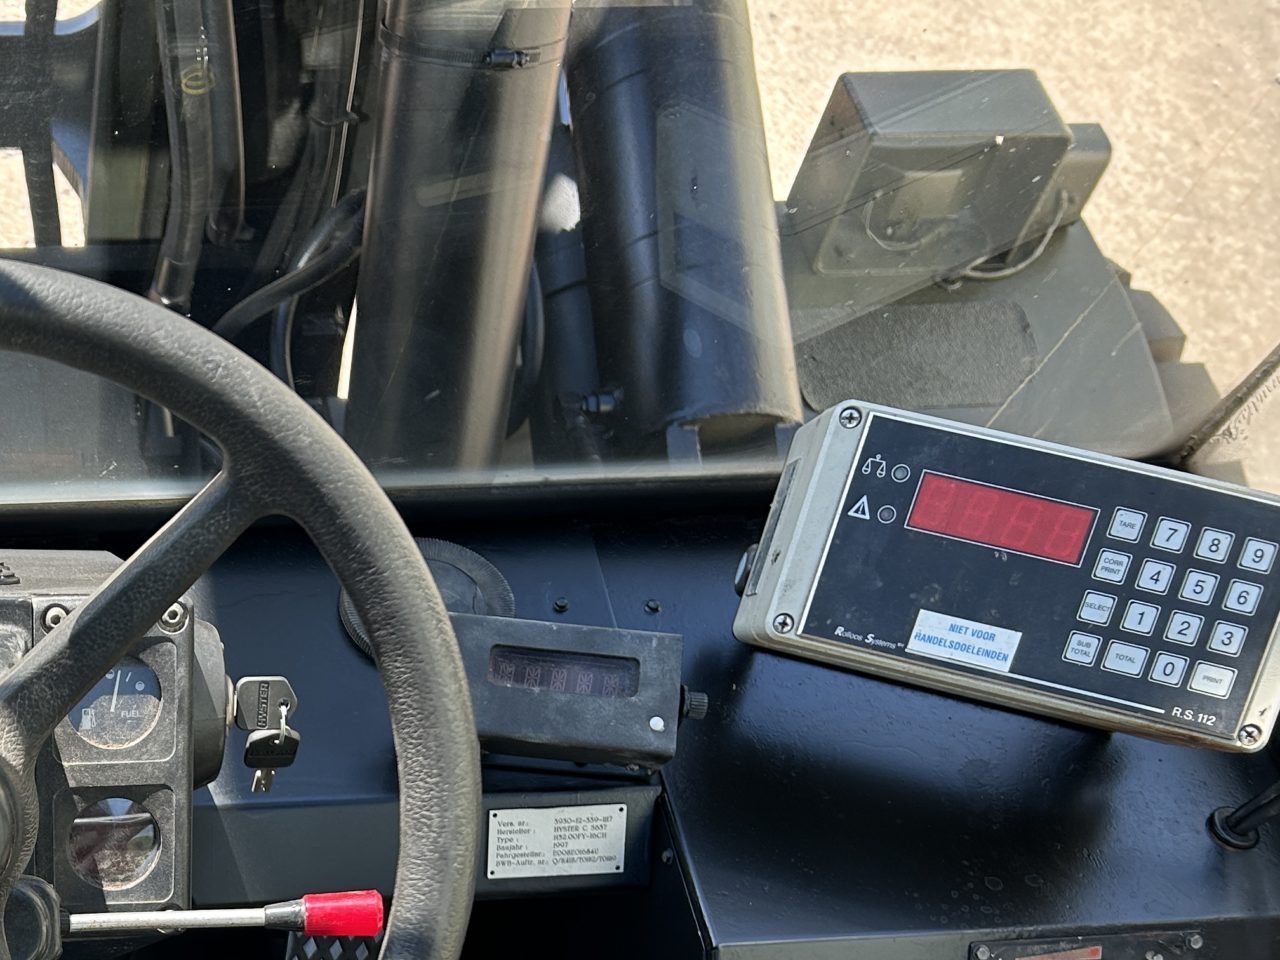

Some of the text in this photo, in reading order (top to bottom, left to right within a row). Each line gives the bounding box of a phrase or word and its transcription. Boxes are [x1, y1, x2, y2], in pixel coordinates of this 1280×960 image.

[1119, 520, 1137, 530] TARE
[1167, 528, 1178, 543] 7
[1209, 538, 1221, 553] 8
[1252, 549, 1265, 564] 9
[1100, 565, 1121, 576] PRINT
[1150, 570, 1162, 585] 4
[1192, 580, 1207, 595] 5
[1236, 591, 1250, 605] 6
[1085, 601, 1110, 612] SELECT
[1137, 612, 1145, 626] 1
[948, 623, 996, 642] NIET VOOR
[1177, 621, 1191, 636] 2
[864, 634, 896, 650] Systems
[1076, 639, 1092, 649] SUB
[1221, 631, 1234, 646] 3
[914, 632, 1009, 663] HANDELSDOELEINDEN
[1070, 647, 1091, 658] TOTAL
[1115, 653, 1136, 664] TOTAL
[1163, 662, 1175, 677] 0
[1202, 674, 1223, 685] PRINT
[121, 710, 143, 718] FUEL
[1172, 707, 1216, 726] R.S. 112
[553, 825, 580, 833] HYSTER
